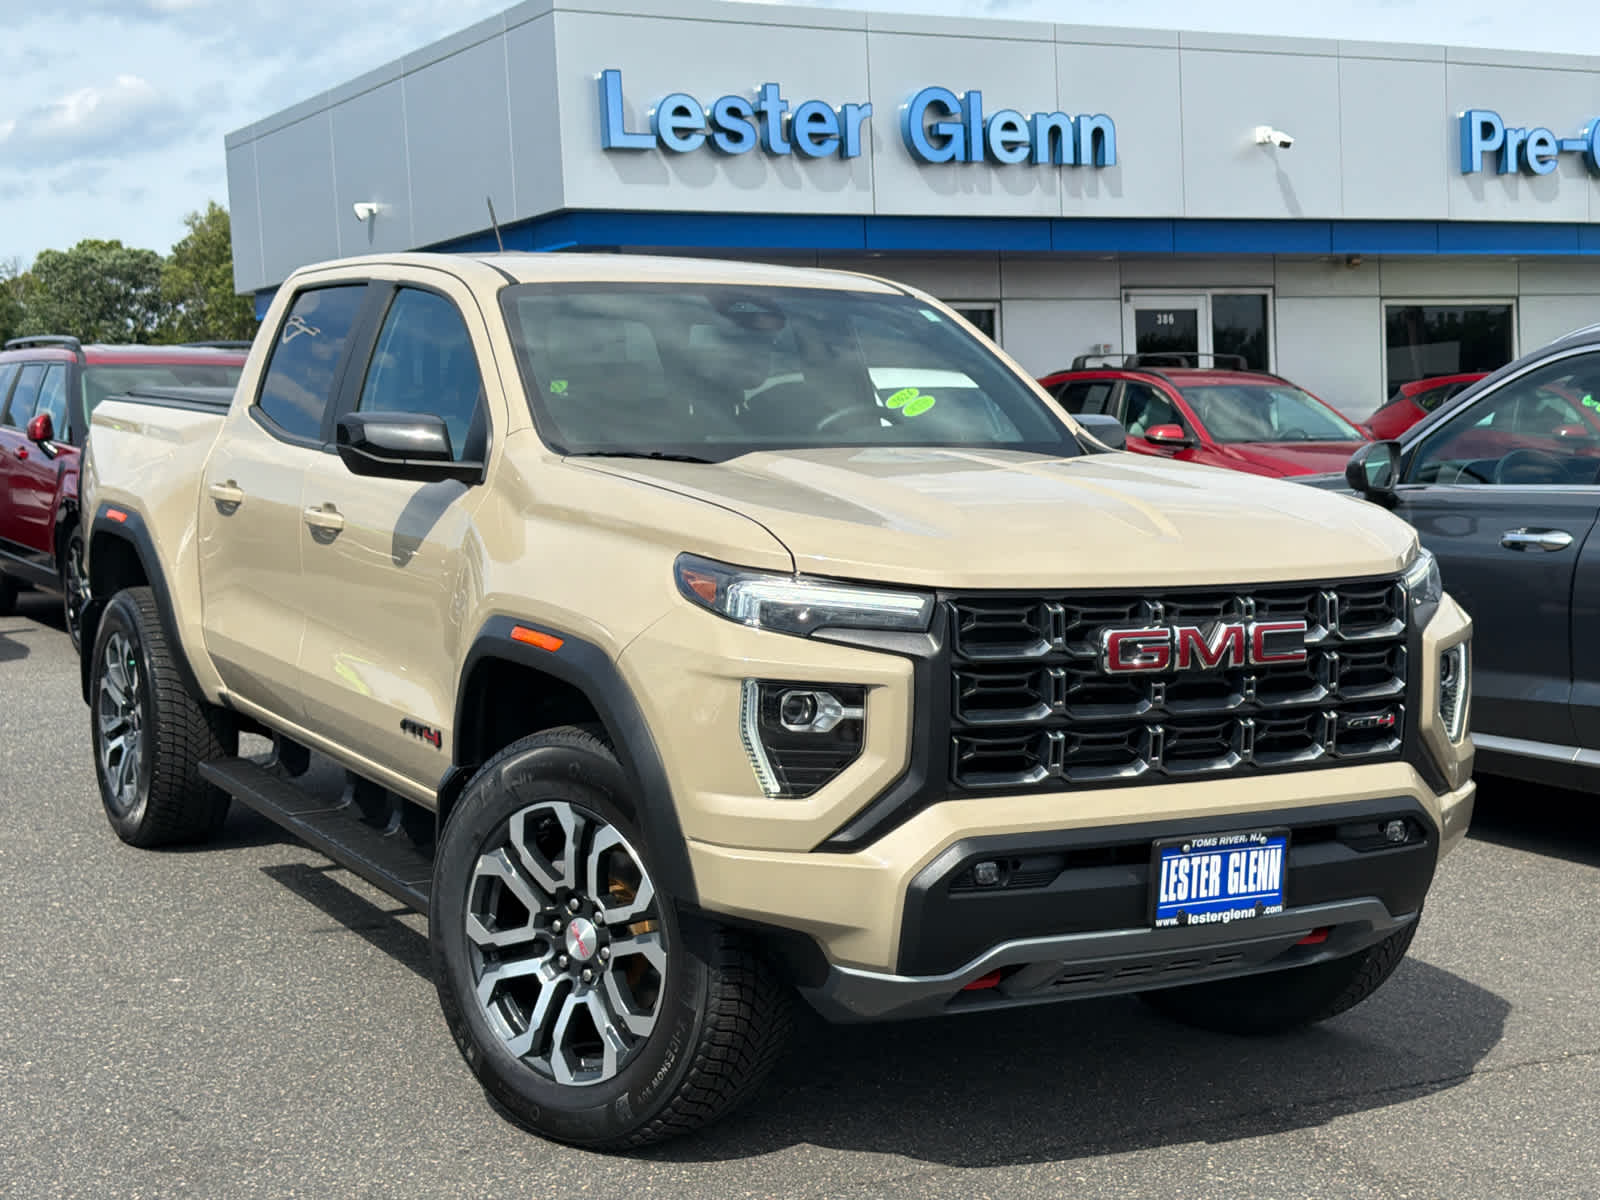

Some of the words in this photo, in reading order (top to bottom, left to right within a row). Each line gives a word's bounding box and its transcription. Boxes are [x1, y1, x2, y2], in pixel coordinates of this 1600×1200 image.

[600, 69, 872, 158] Lester
[901, 86, 1117, 166] Glenn
[1460, 109, 1600, 178] Pre-
[1103, 621, 1307, 673] GMC
[1191, 838, 1217, 848] TOMS
[1160, 855, 1221, 902] LESTER
[1228, 849, 1282, 894] GLENN
[1187, 908, 1256, 925] lesterglenn
